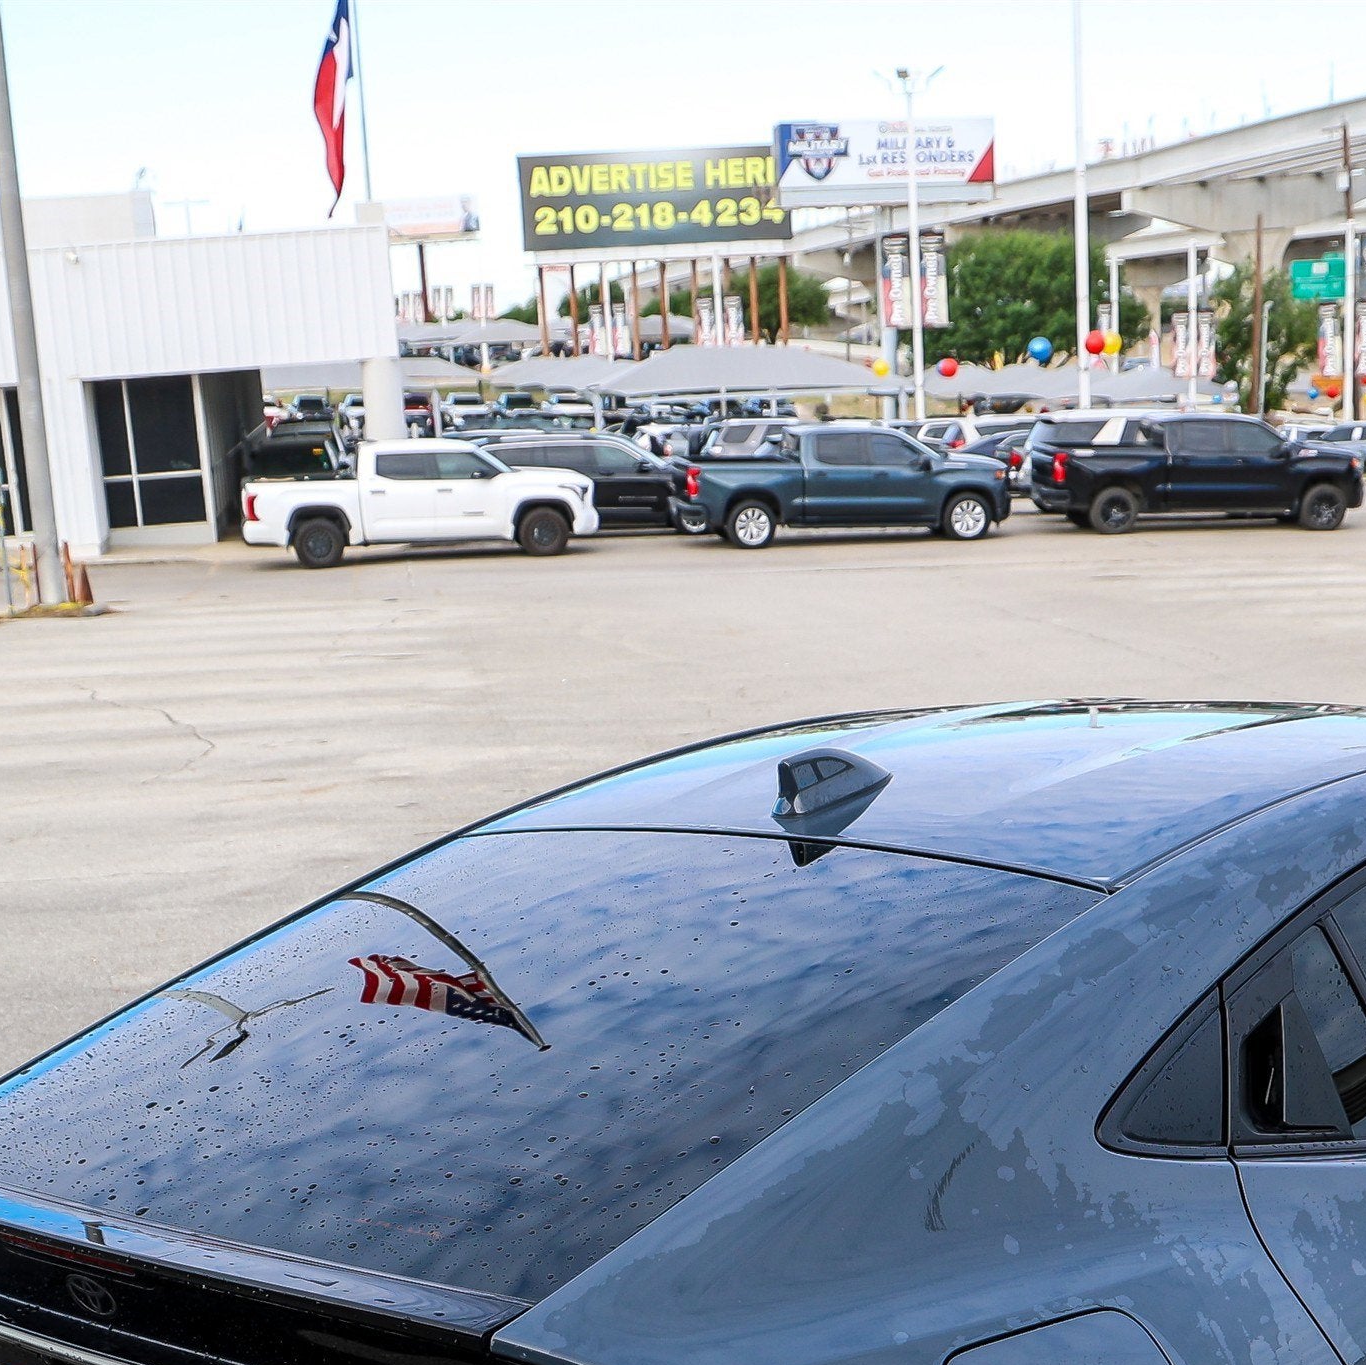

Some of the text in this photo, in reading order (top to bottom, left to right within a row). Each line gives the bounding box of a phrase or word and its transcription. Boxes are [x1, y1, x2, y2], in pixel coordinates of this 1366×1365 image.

[877, 135, 942, 150] MILIARY
[881, 151, 974, 164] RESONDERS
[529, 160, 694, 198] ADVERTISE
[535, 196, 785, 236] 210-218-4234
